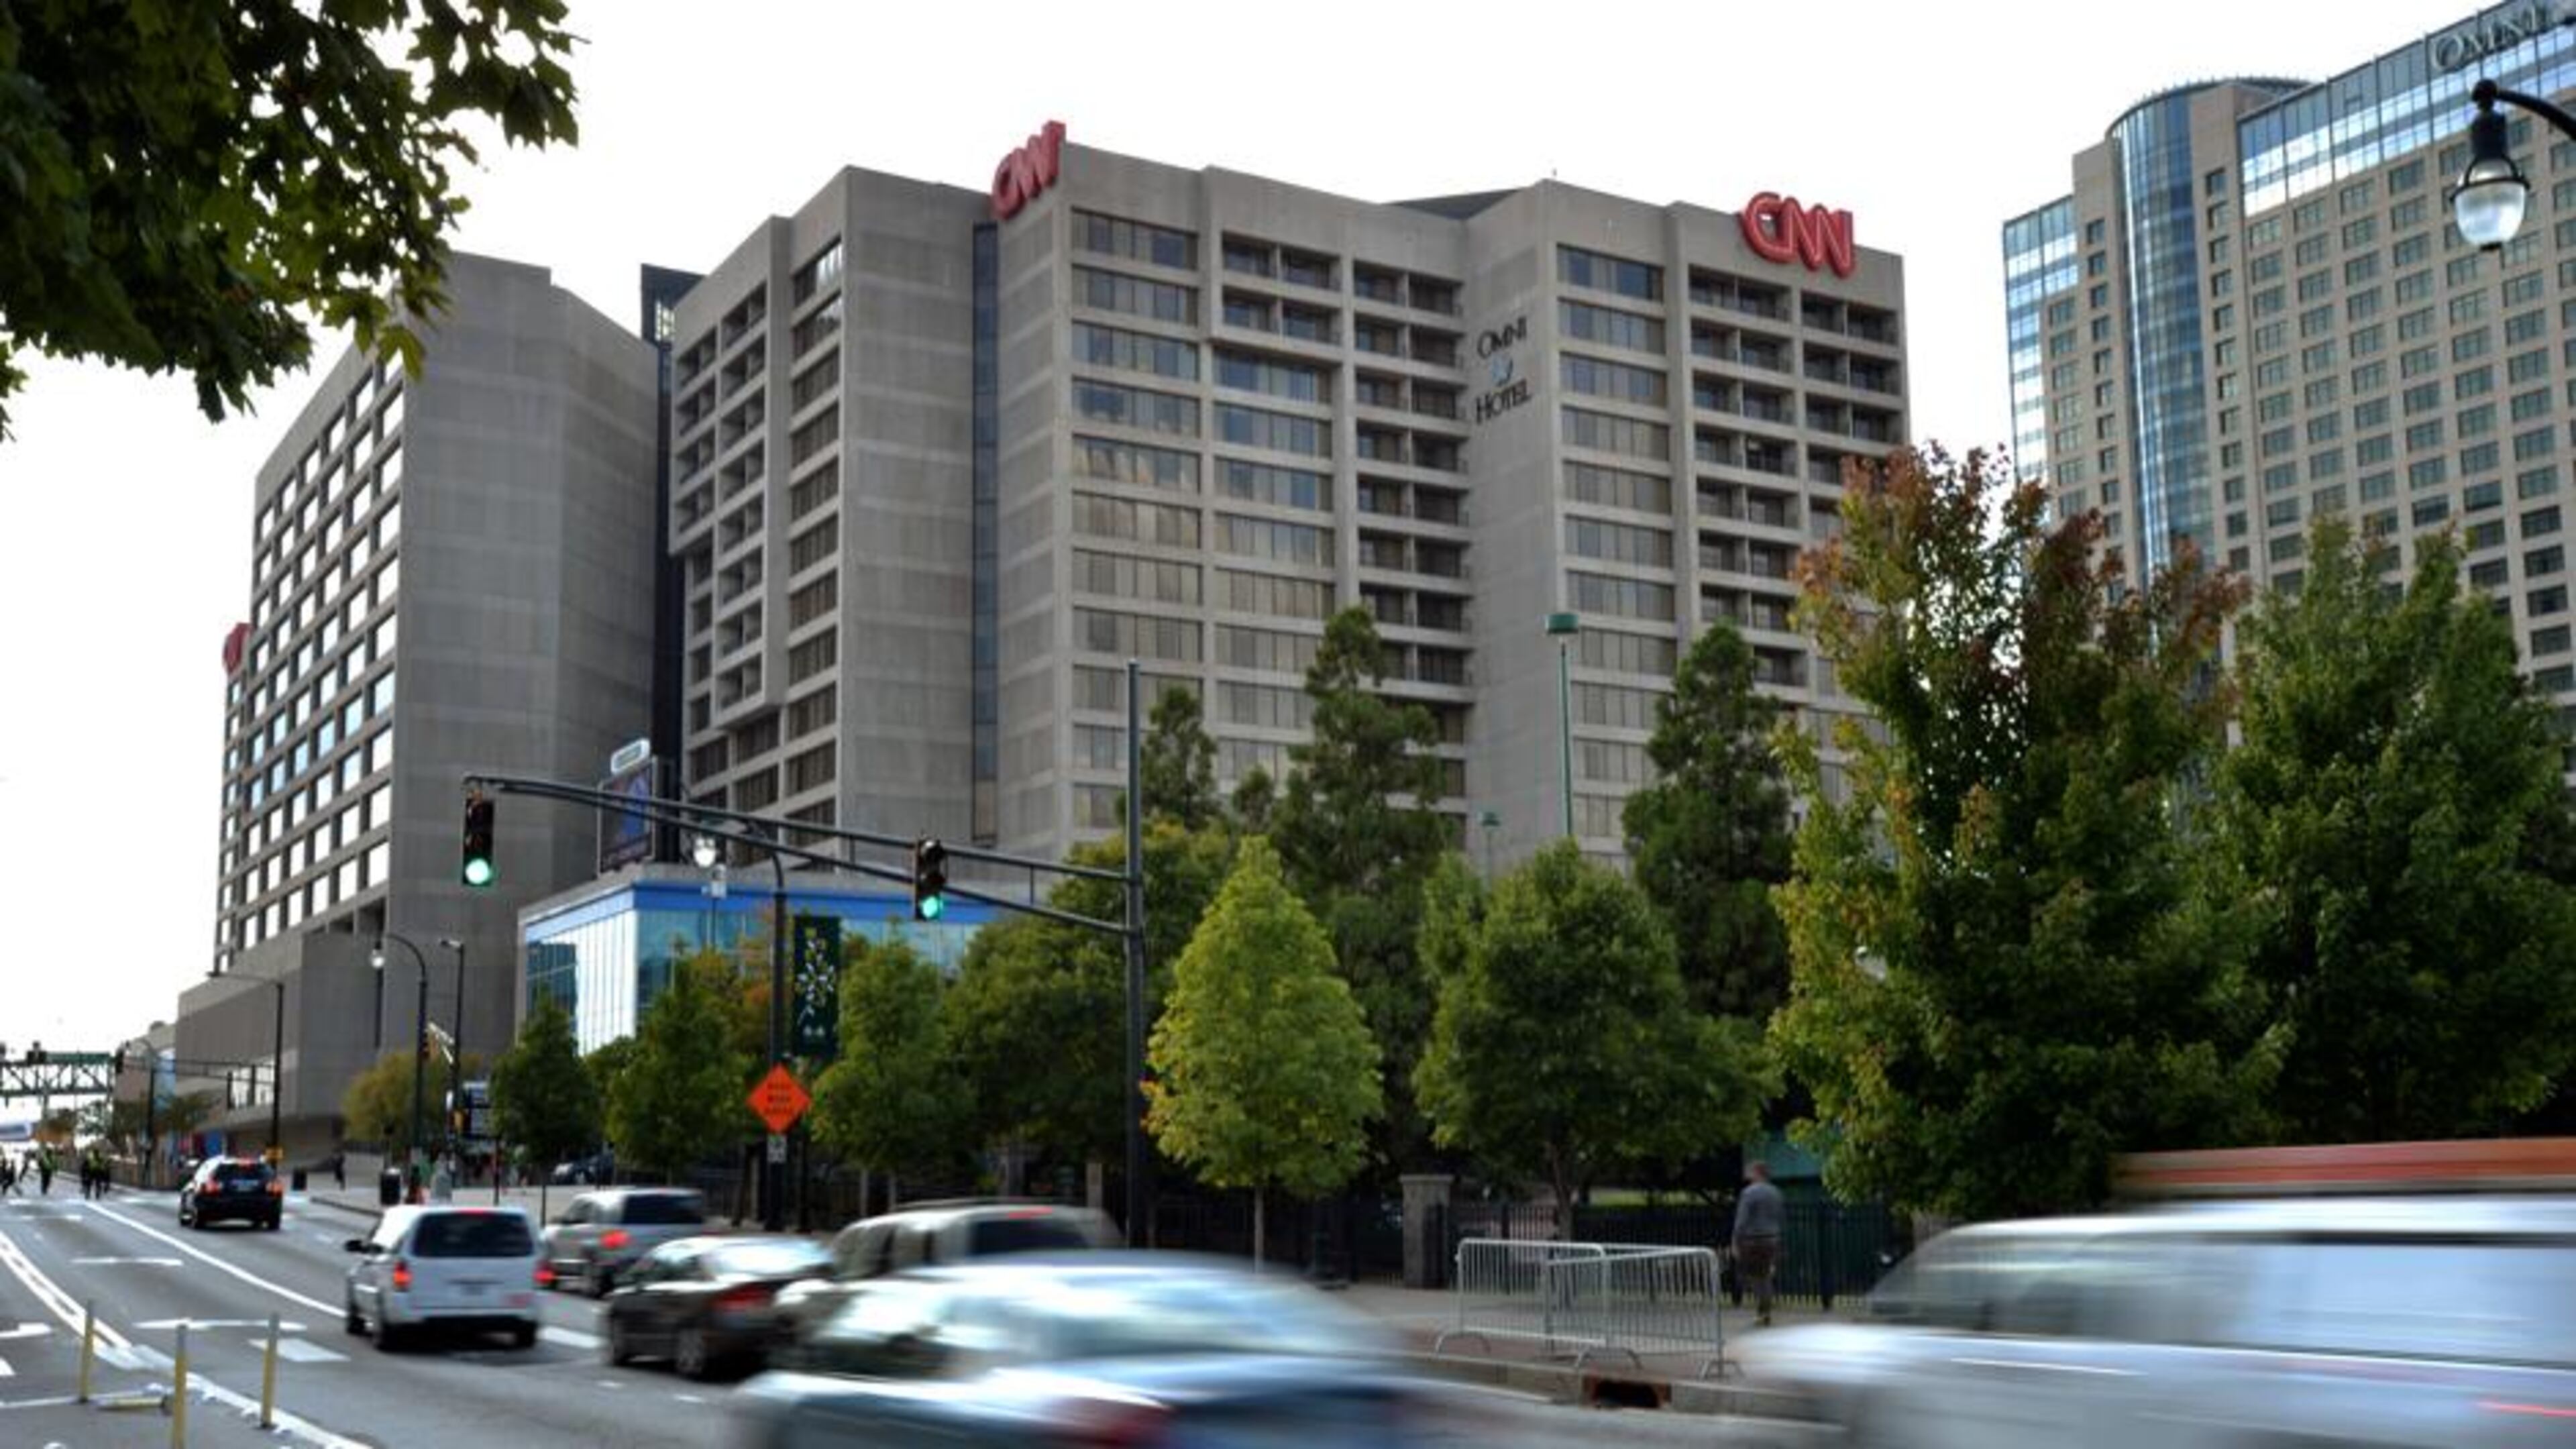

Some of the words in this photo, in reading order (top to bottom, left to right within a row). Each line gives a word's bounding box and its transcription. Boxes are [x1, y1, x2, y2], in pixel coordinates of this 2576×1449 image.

[992, 120, 1066, 221] CNN
[1741, 192, 1854, 278] CNN
[1478, 317, 1527, 359] OMNI
[1477, 378, 1533, 425] HOTEL
